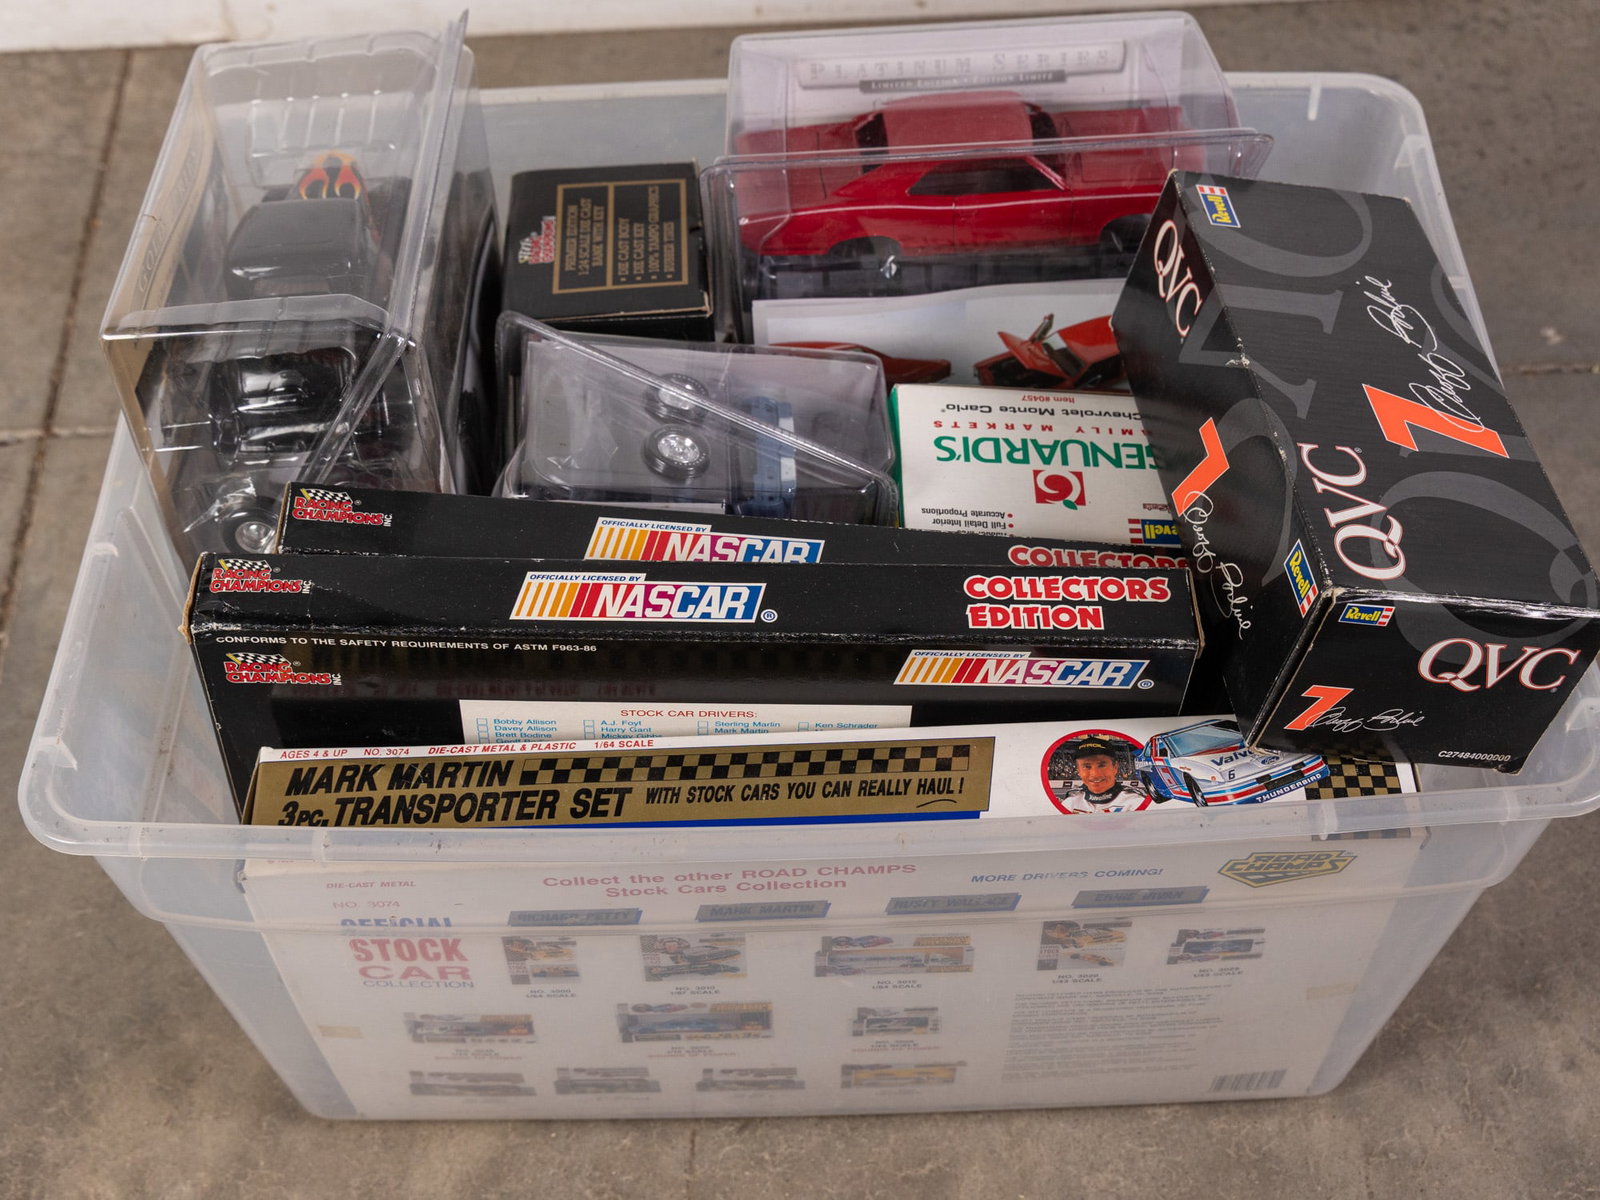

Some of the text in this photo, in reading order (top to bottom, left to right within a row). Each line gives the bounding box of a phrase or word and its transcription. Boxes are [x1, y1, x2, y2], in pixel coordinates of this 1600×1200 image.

[580, 198, 592, 218] CAST
[1207, 194, 1232, 224] Revell
[618, 240, 630, 260] CAST
[633, 238, 645, 260] CAST
[1153, 219, 1203, 337] QVC
[945, 403, 1143, 421] Chevrolet Monte Carlo
[933, 420, 1054, 432] MARKETS
[1362, 383, 1510, 459] 7
[293, 496, 353, 512] RACING
[1296, 442, 1408, 581] QVC
[292, 508, 384, 526] CHAMPIONS
[921, 507, 1005, 519] Accurate Proportions
[601, 519, 650, 529] OFFICIALLY
[650, 523, 694, 532] LICENSED
[932, 518, 1006, 530] Full Detail Interior
[1144, 524, 1179, 540] evell
[662, 533, 810, 563] NASCAR
[212, 568, 271, 580] RACING
[529, 573, 581, 582] OFFICIALLY
[581, 574, 627, 582] LICENSED
[1288, 549, 1311, 600] Revell
[209, 579, 302, 594] CHAMPIONS
[964, 574, 1171, 602] COLLECTORS
[592, 584, 751, 619] NASCAR
[966, 603, 1105, 630] EDITION
[1345, 605, 1381, 622] Revell
[215, 636, 597, 652] CONFORMS TO THE SAFETY REQUIREMENTS OF ASTM F963-86
[914, 651, 965, 659] OFFICIALLY
[224, 661, 293, 674] RACING
[973, 659, 1133, 687] NASCAR
[1417, 637, 1582, 693] QVC
[226, 672, 332, 686] CHAMPIONS
[620, 709, 664, 717] STOCK
[1283, 684, 1355, 731] 7
[493, 718, 557, 726] Bobby Allison
[494, 725, 525, 733] Davey
[363, 748, 410, 756] NO. 3074
[428, 742, 577, 755] DIE-CAST METAL & PLASTIC
[594, 739, 654, 749] 1/64 SCALE
[280, 750, 310, 759] AGES
[313, 750, 320, 758] 4
[333, 749, 348, 757] UP
[1211, 750, 1254, 767] Valv
[285, 760, 515, 797] MARK MARTIN
[1228, 769, 1236, 780] 6
[645, 786, 681, 804] WITH
[686, 785, 734, 803] STOCK
[740, 783, 780, 802] CARS
[786, 782, 817, 800] YOU
[822, 781, 852, 798] CAN
[857, 779, 911, 797] REALLY
[1256, 773, 1322, 803] THUNDERBIRD
[333, 788, 561, 827] TRANSPORTER
[569, 787, 633, 819] SET
[543, 864, 917, 887] Collect the other ROAD CHAMPS
[970, 868, 1164, 883] MORE DRIVERS COMING!
[605, 879, 847, 898] Stock Cars Collection
[367, 900, 401, 908] 3074
[759, 904, 815, 914] MARTIN
[349, 937, 469, 962] STOCK
[358, 965, 472, 980] CAR
[363, 980, 474, 988] COLLECTION
